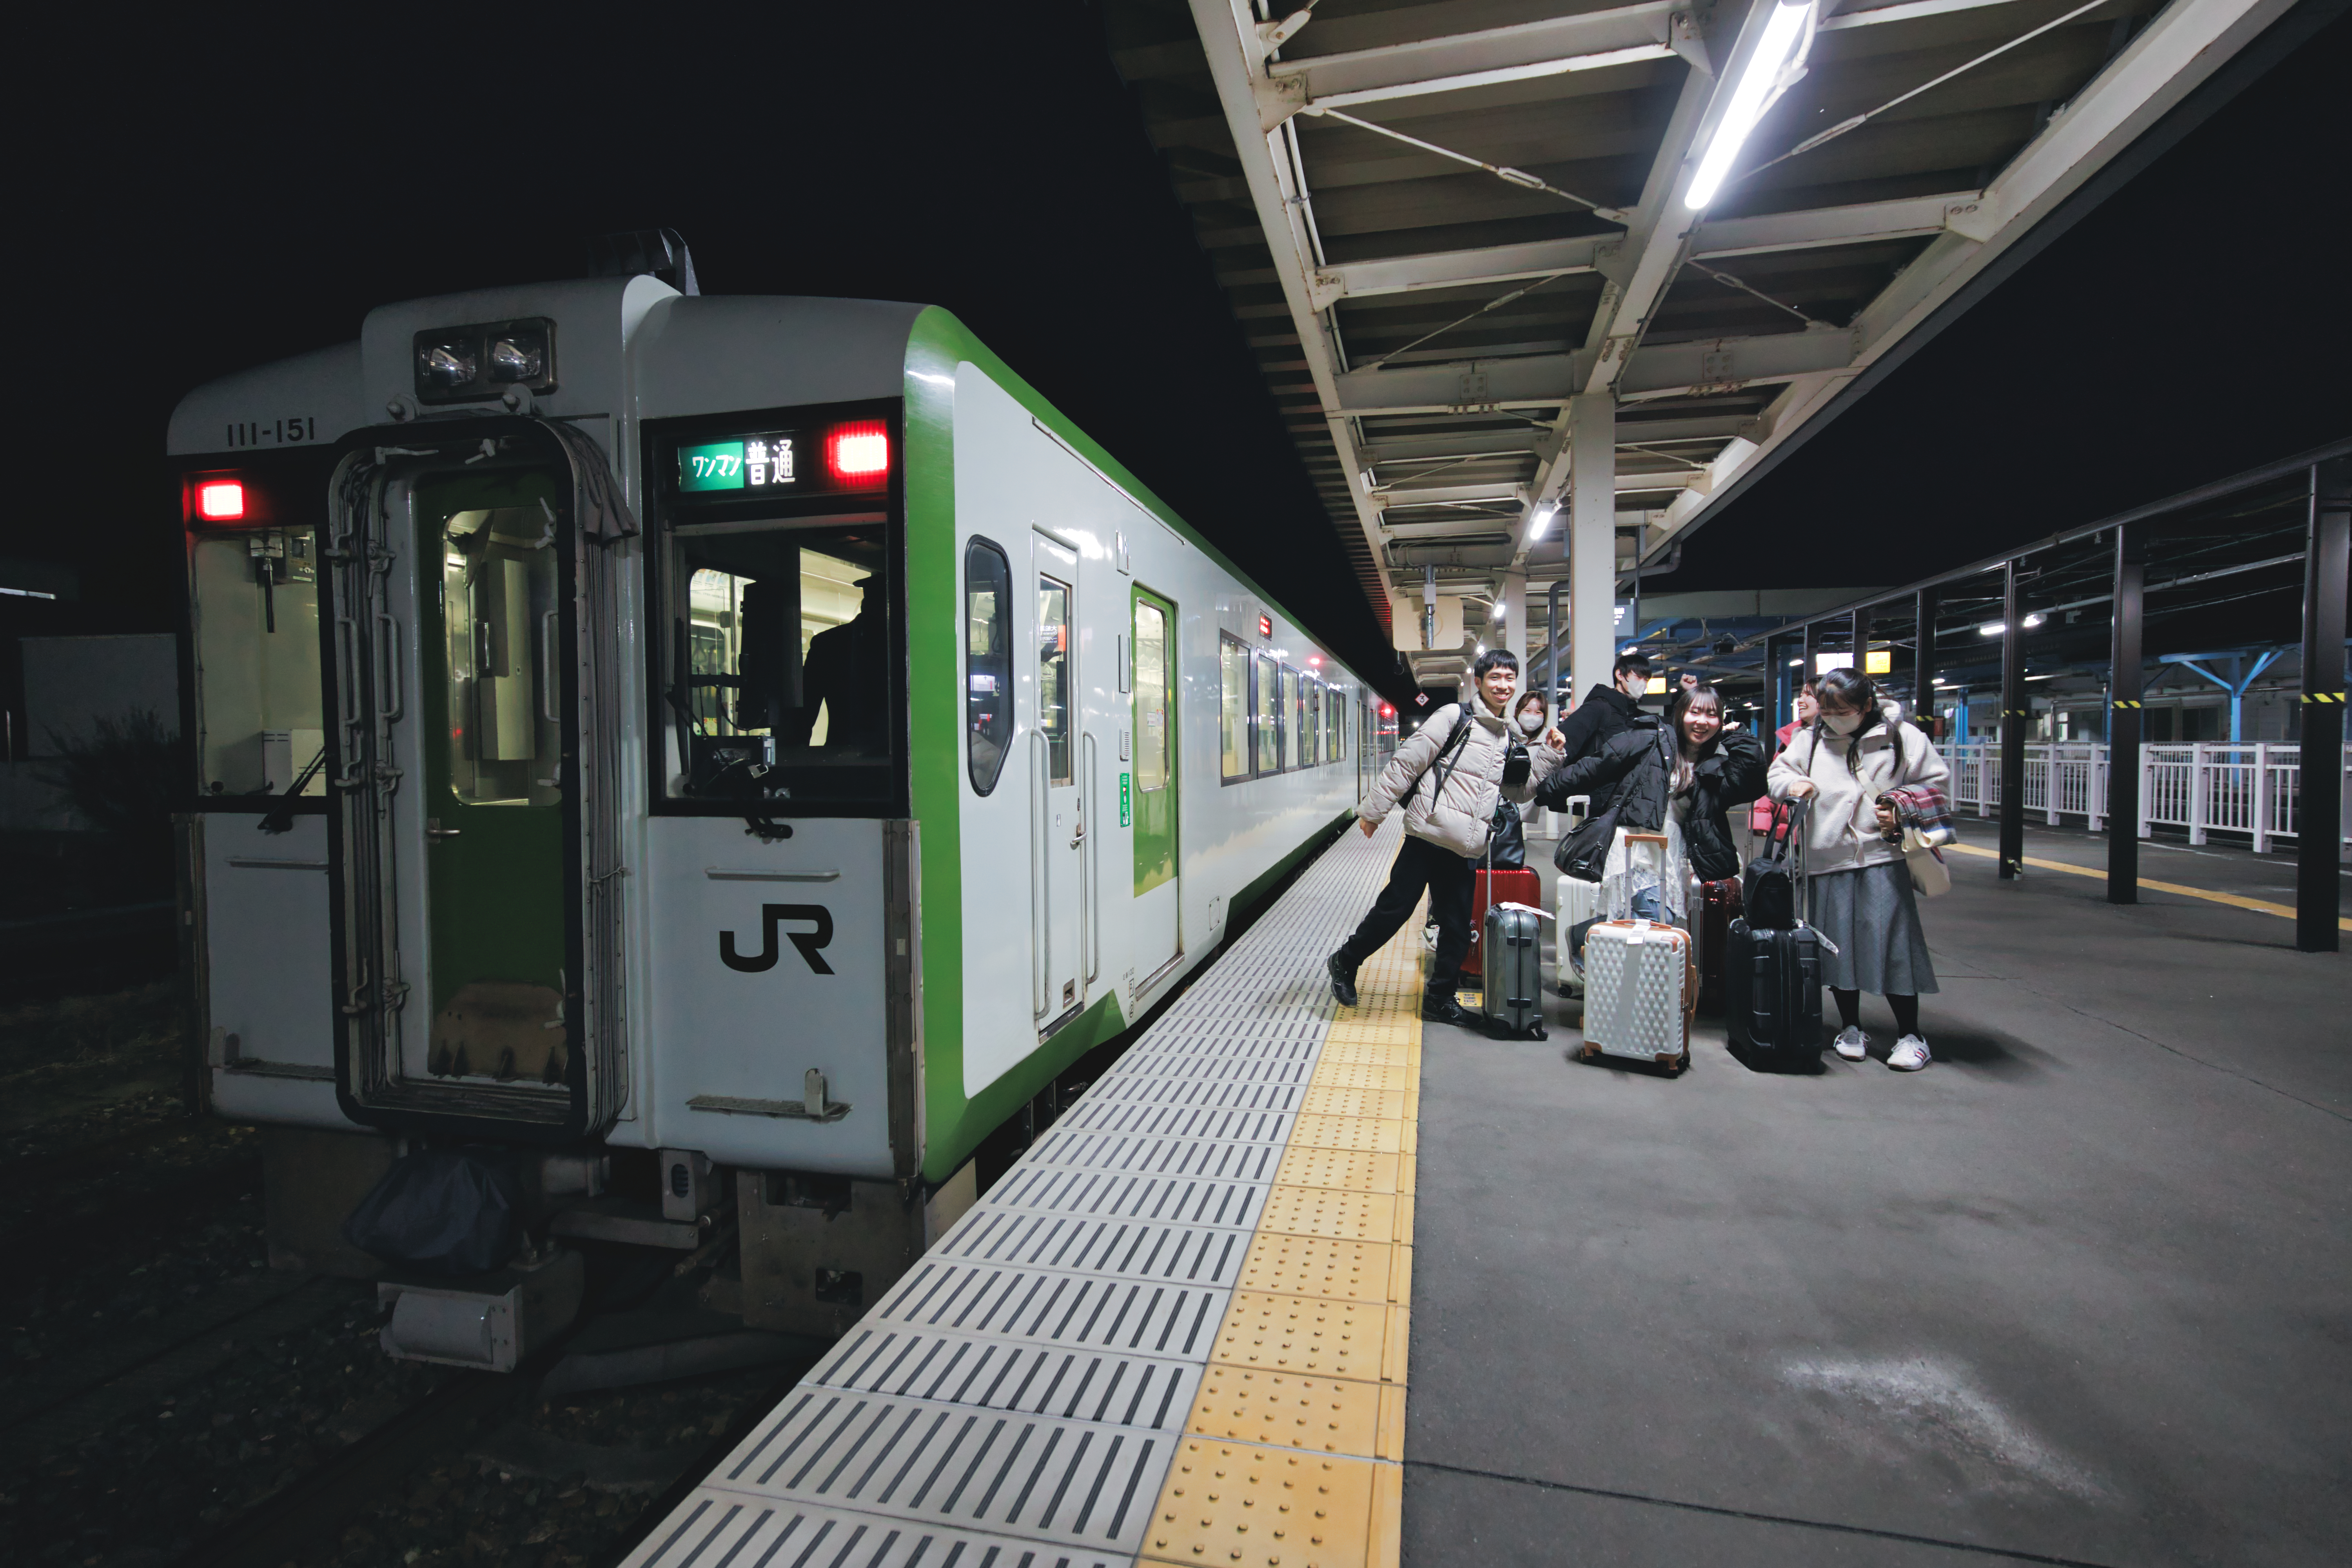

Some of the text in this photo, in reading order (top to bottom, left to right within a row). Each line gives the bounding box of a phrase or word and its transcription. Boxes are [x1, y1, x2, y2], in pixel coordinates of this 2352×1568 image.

[227, 417, 314, 447] 111-151
[692, 439, 795, 485] ワンマン 普通
[720, 904, 835, 975] JR
